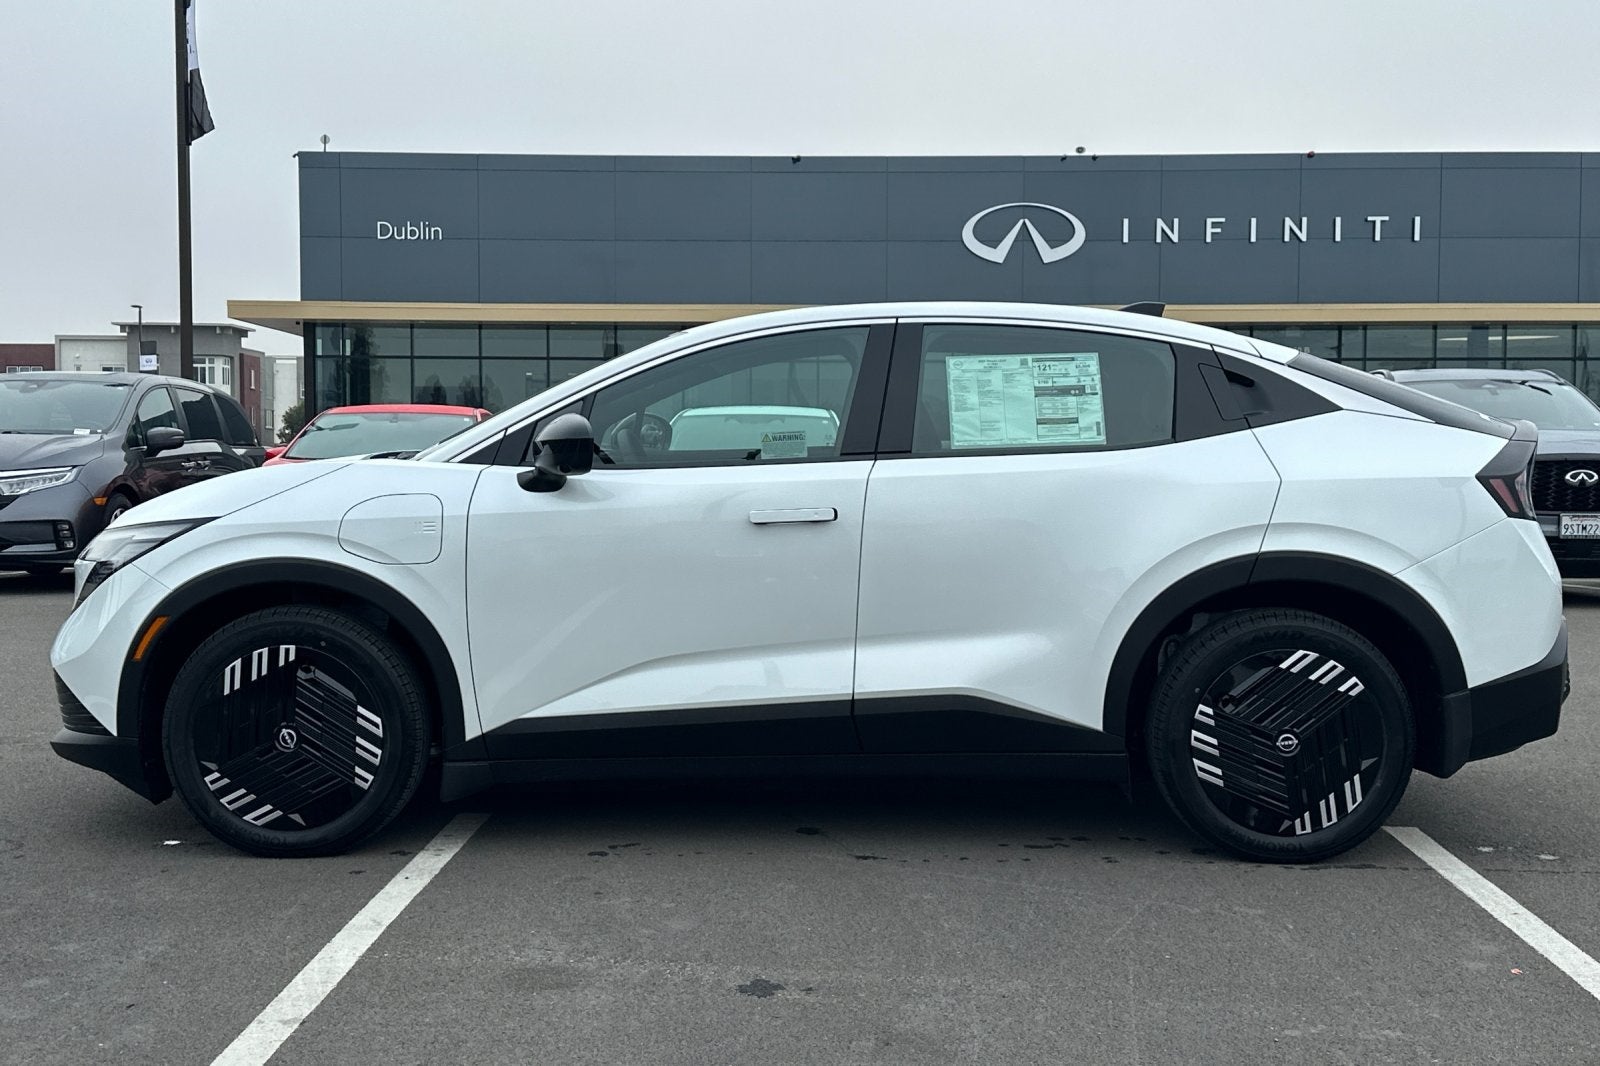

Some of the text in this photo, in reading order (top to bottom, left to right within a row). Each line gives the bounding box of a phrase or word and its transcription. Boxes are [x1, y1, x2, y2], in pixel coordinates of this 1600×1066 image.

[376, 221, 443, 241] Dublin
[1122, 216, 1421, 243] INFINITI
[1037, 364, 1052, 372] 121
